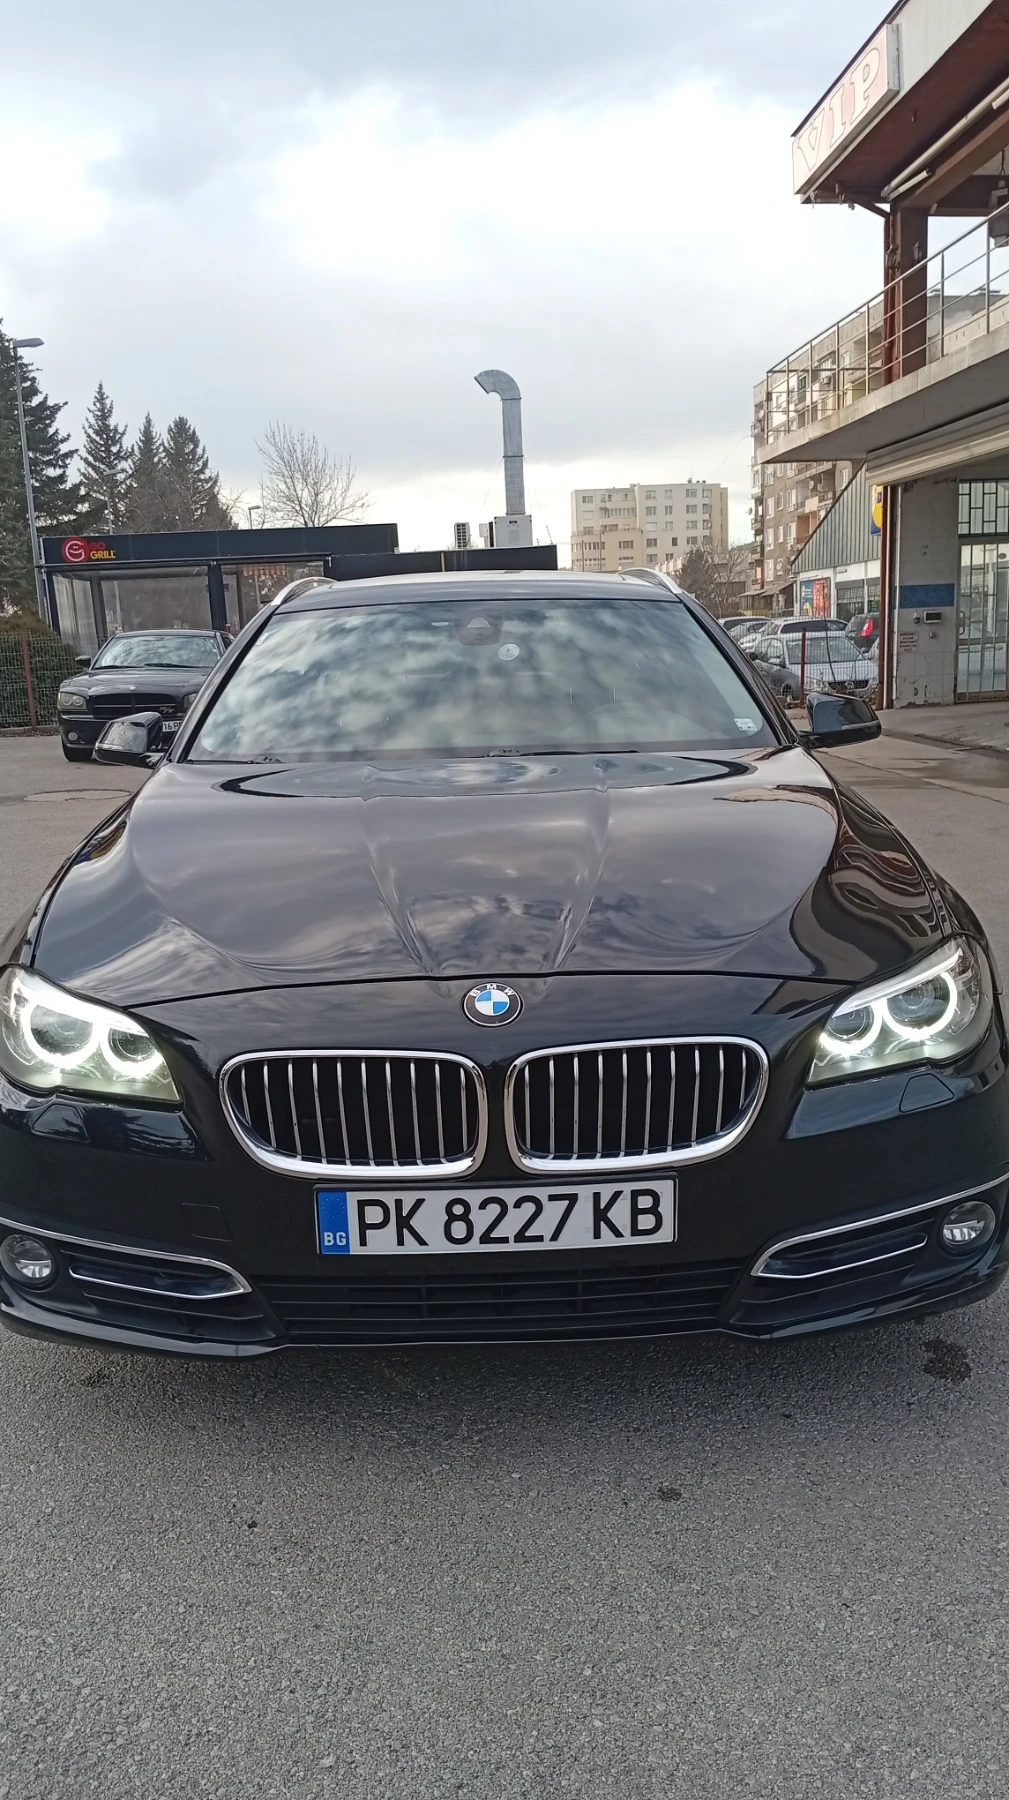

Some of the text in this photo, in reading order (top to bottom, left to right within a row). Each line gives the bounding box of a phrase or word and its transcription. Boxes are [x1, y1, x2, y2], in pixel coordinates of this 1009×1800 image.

[797, 47, 881, 173] VIP
[90, 542, 106, 550] GO
[90, 550, 116, 560] GRILL
[470, 983, 515, 997] BMW
[356, 1188, 664, 1247] PK 8227 KB
[323, 1231, 347, 1246] BG
